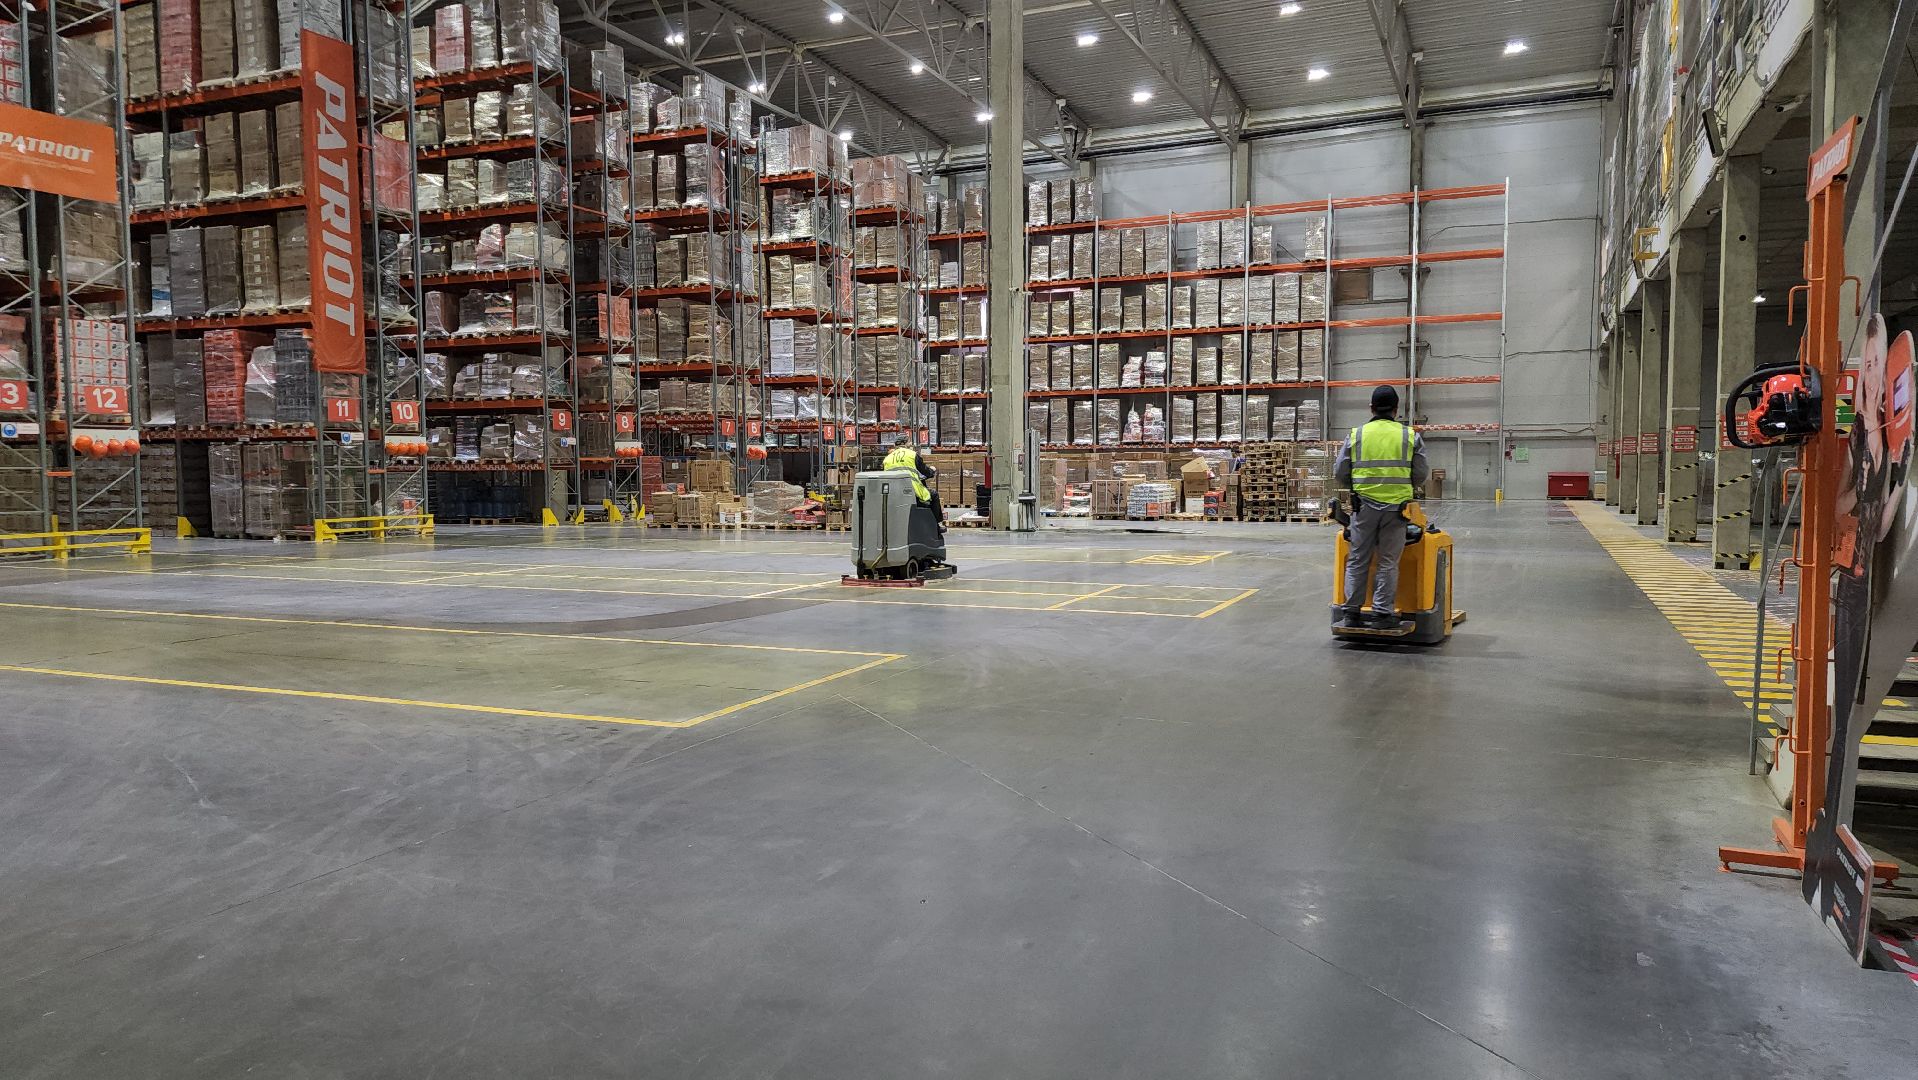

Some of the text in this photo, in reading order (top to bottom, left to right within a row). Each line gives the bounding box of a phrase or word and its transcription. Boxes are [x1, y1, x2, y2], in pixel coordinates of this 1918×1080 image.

[0, 131, 94, 162] PATRIOT
[1811, 133, 1851, 186] PATRIOT
[315, 71, 355, 336] PATRIOT
[92, 388, 118, 409] 12
[336, 399, 349, 417] 11
[396, 403, 414, 420] 10
[558, 412, 566, 427] 9
[621, 415, 629, 429] 8
[725, 421, 731, 433] 7
[751, 422, 758, 434] 6
[827, 425, 832, 437] 5
[848, 427, 853, 438] 4
